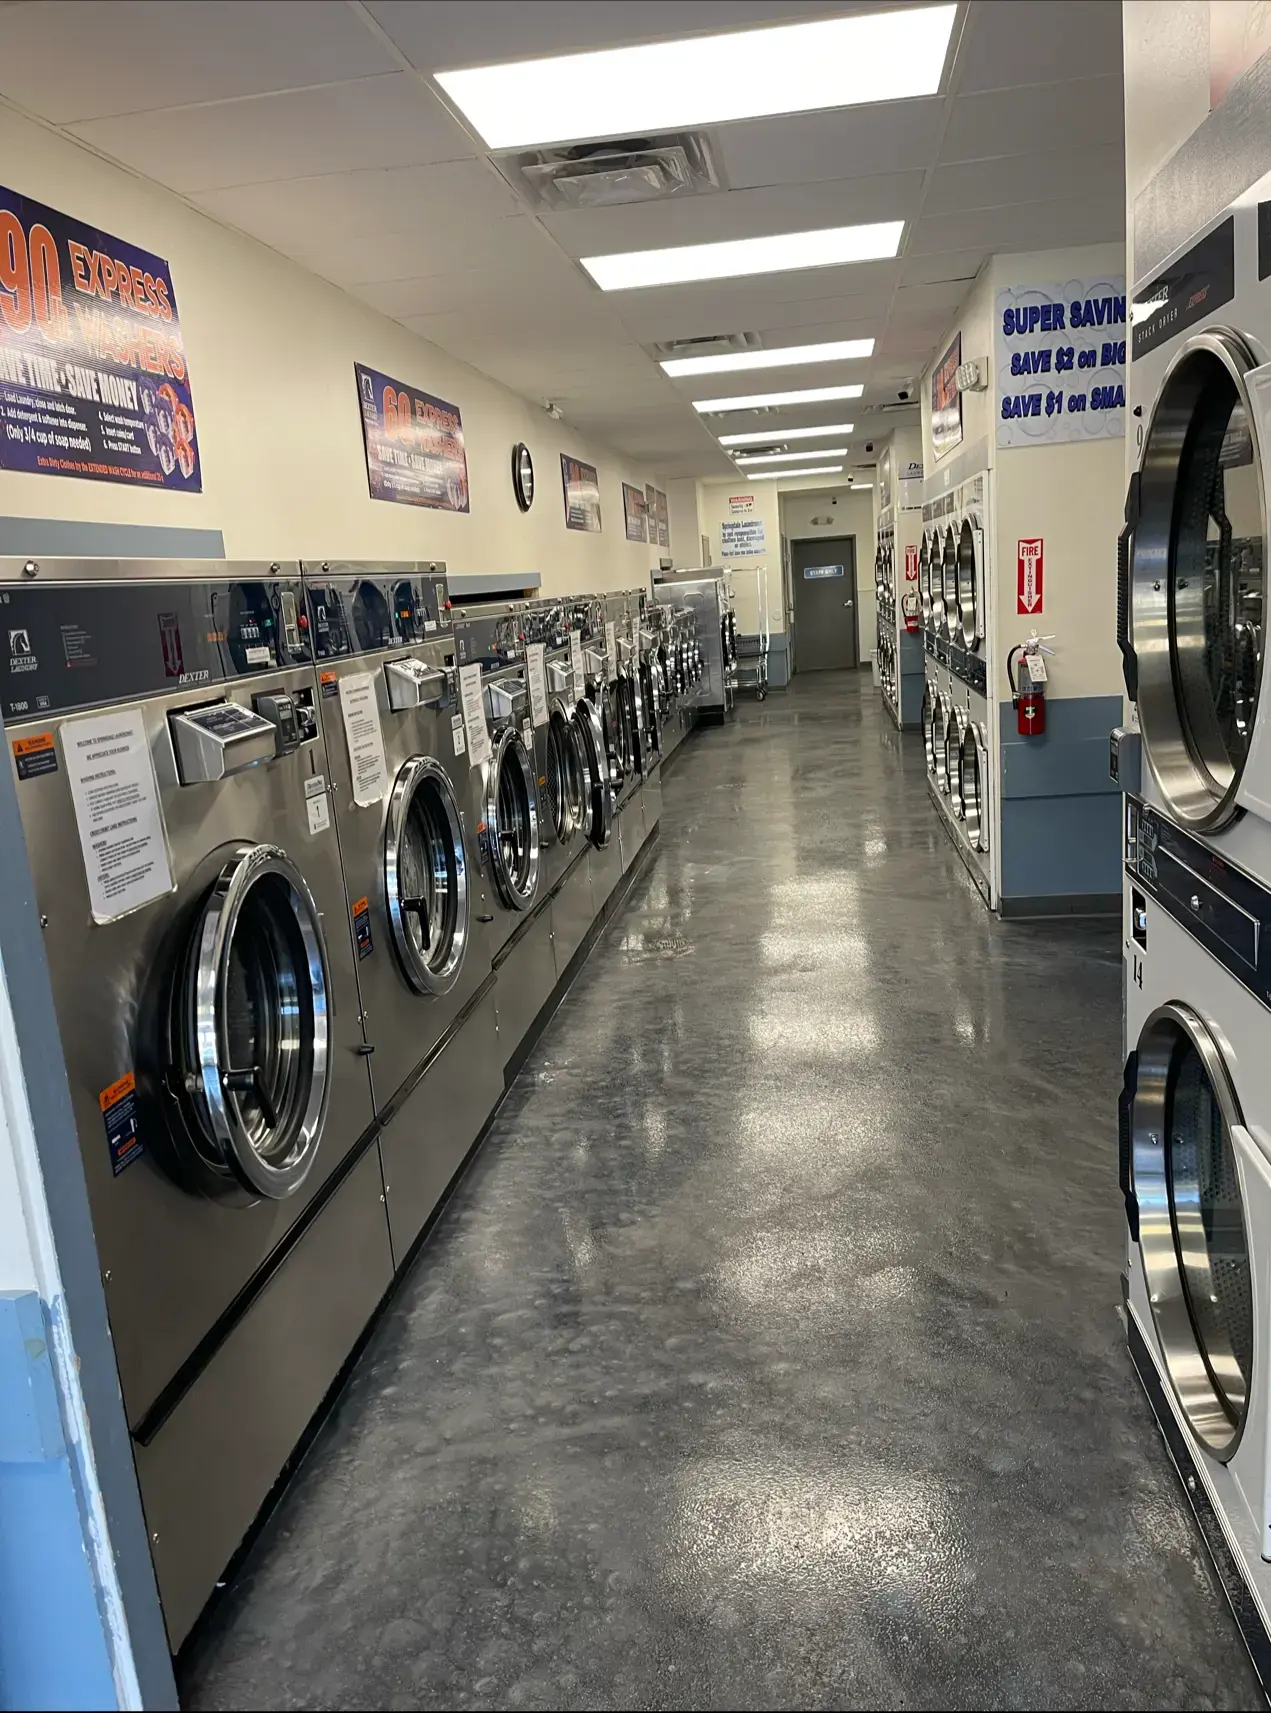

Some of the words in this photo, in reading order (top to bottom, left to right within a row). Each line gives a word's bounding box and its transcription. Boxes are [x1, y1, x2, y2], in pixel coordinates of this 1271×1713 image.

[0, 209, 62, 343] 90
[68, 239, 172, 322] EXPRESS
[1003, 303, 1065, 336] SUPER
[1138, 324, 1155, 343] STACK
[1159, 308, 1177, 329] DRYER
[73, 302, 185, 381] WASHERS
[1011, 349, 1052, 376] SAVE
[1055, 347, 1075, 373] $2
[1078, 349, 1097, 369] on
[22, 354, 61, 392] TIME
[65, 363, 101, 402] SAVE
[97, 371, 138, 411] MONEY
[0, 405, 6, 417] 2.
[7, 407, 16, 418] Add
[17, 408, 38, 423] detergent
[47, 400, 55, 411] and
[383, 385, 411, 443] 60
[415, 398, 459, 433] EXPRESS
[1001, 393, 1042, 419] SAVE
[1045, 391, 1063, 417] $1
[1067, 394, 1086, 412] on
[6, 423, 24, 443] (Only
[24, 425, 36, 443] 3/4
[36, 430, 48, 447] cup
[48, 431, 55, 445] of
[55, 434, 69, 449] soap
[69, 436, 92, 453] needed)
[37, 456, 49, 467] Extra
[49, 457, 60, 470] Dirty
[1022, 546, 1039, 556] FIRE
[10, 656, 37, 666] DEXTER
[11, 664, 38, 673] LAUNDRY
[179, 670, 209, 684] DEXTER
[1133, 955, 1143, 990] 14
